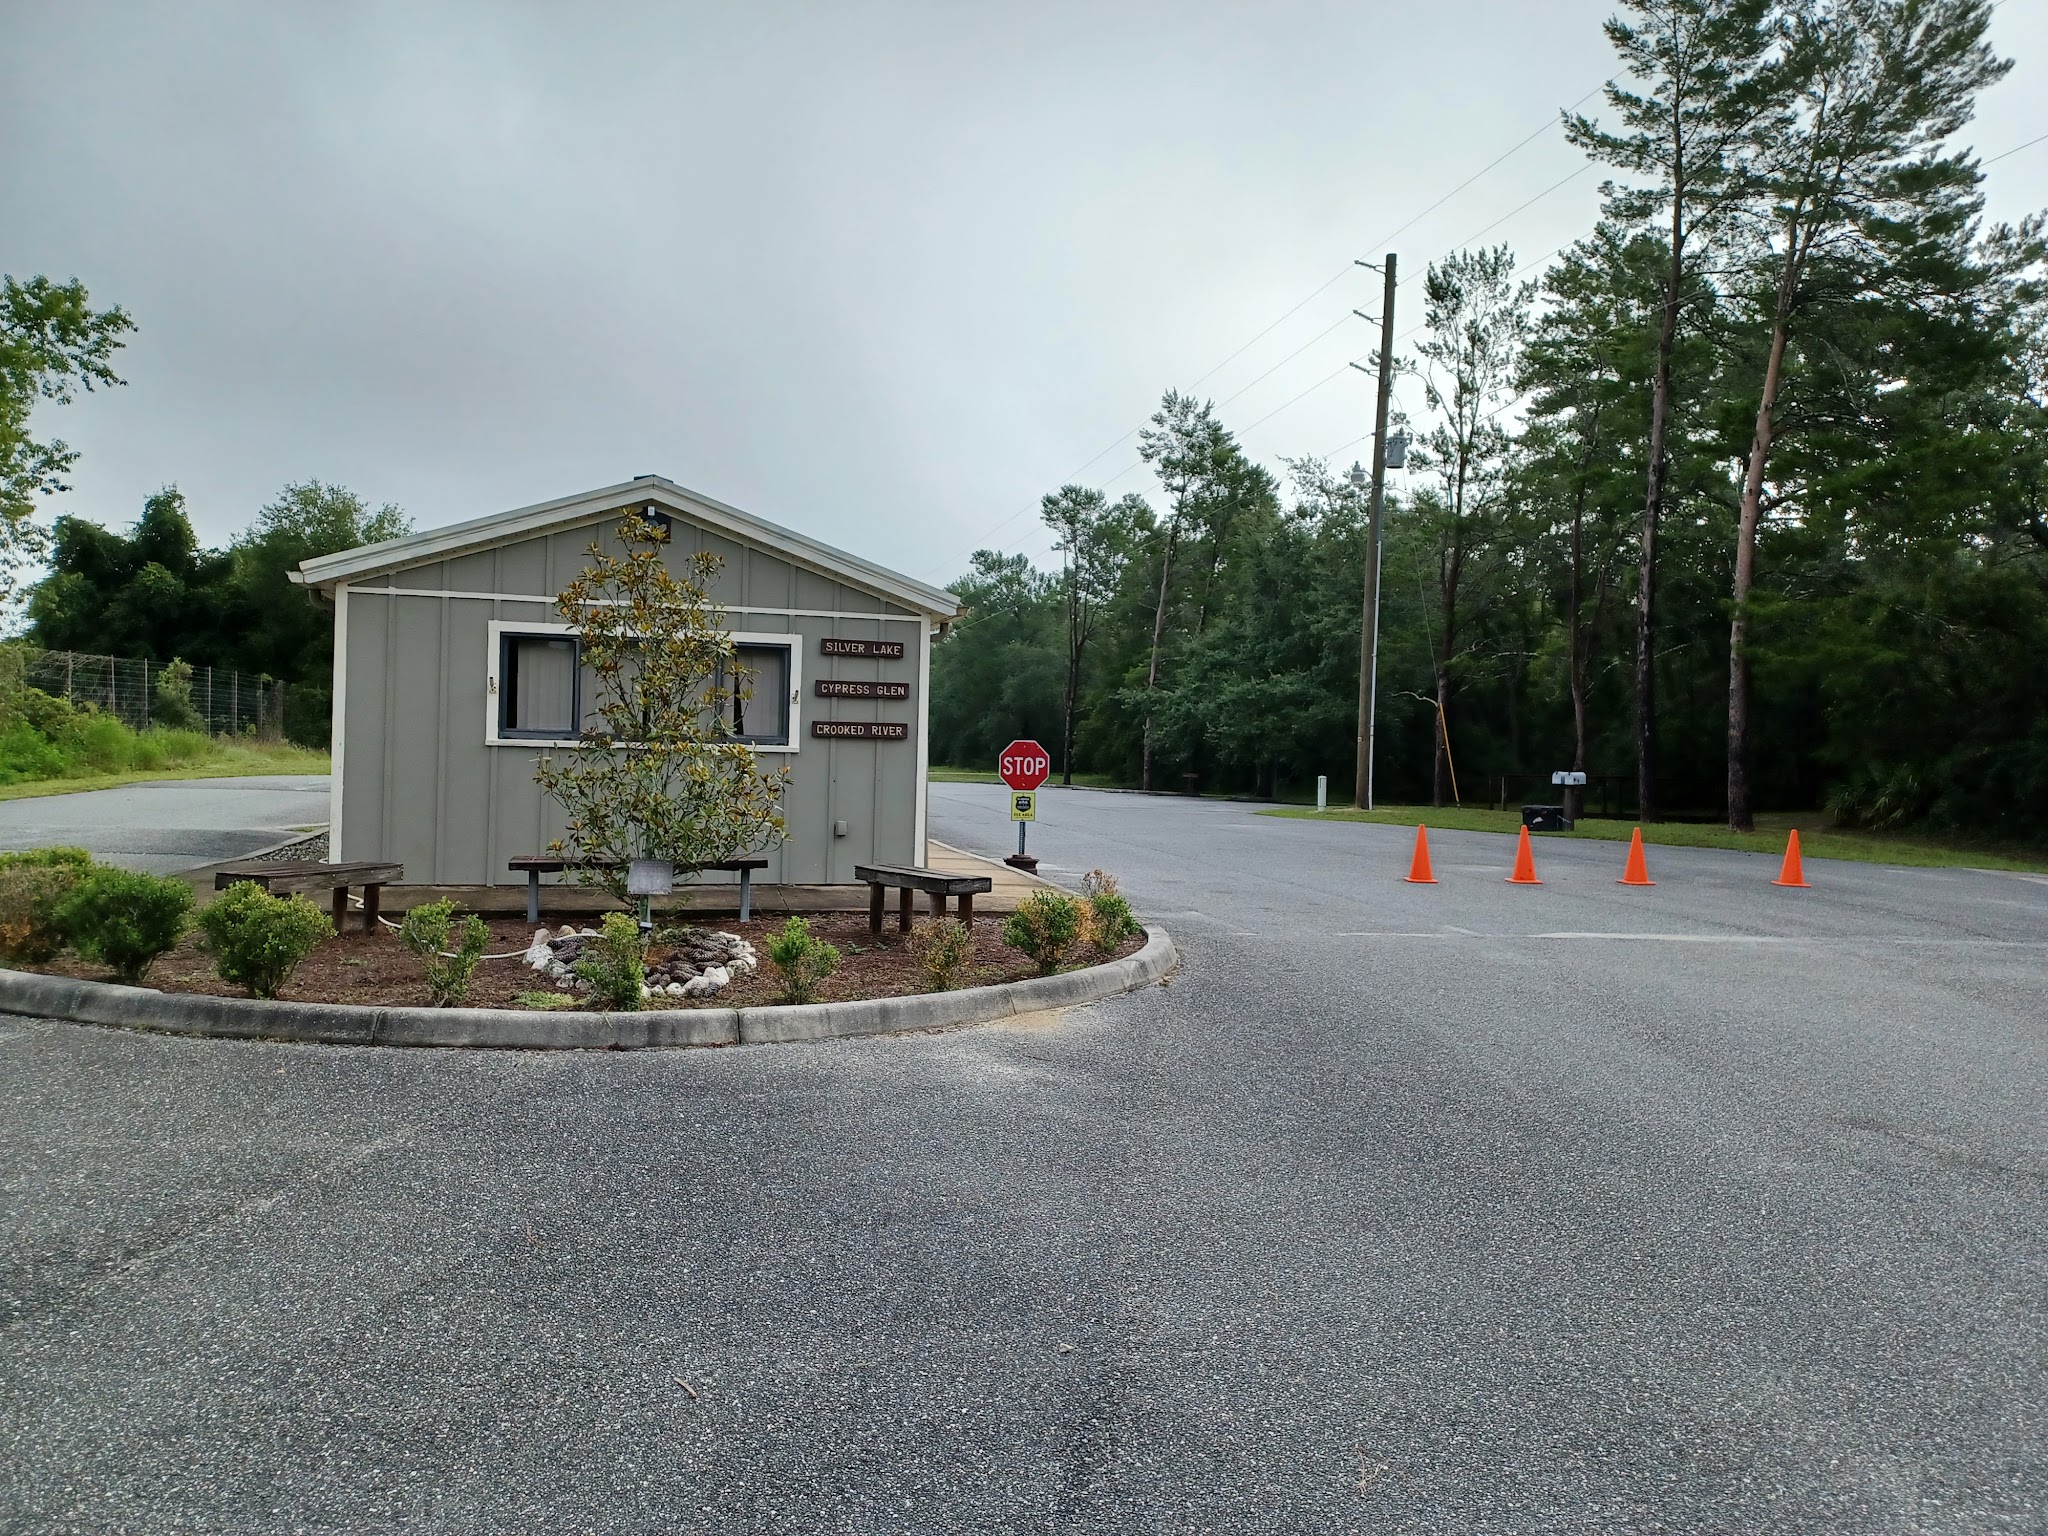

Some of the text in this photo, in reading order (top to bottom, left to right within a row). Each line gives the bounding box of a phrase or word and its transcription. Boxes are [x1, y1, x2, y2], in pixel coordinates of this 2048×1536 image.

[825, 642, 901, 655] SILVER LAKE
[821, 684, 905, 696] CYPRESS GLEN
[816, 724, 903, 736] CROOKED RIVER
[1003, 756, 1046, 775] STOP
